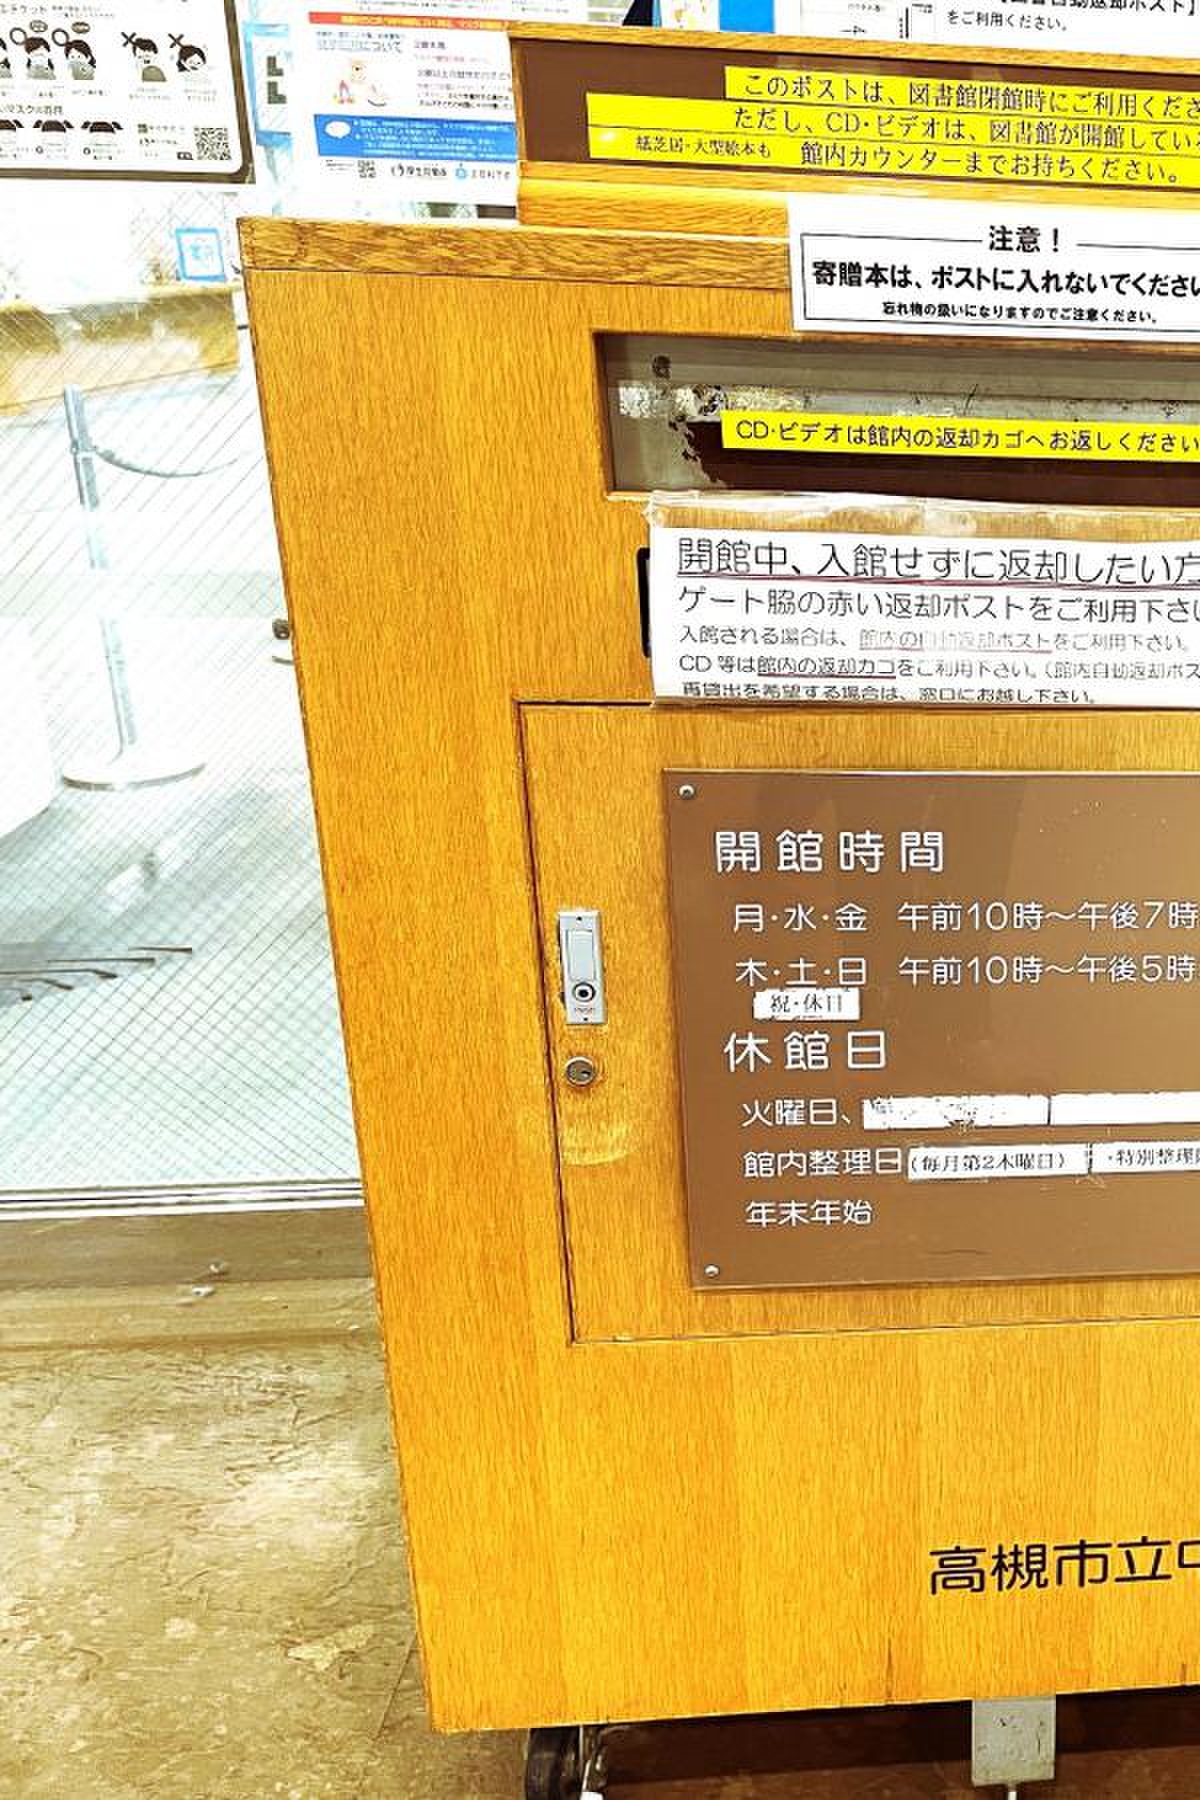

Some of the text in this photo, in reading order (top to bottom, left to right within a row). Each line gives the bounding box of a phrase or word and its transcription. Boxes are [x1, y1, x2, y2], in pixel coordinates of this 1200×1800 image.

[946, 10, 1067, 32] をご利用ください。
[800, 141, 1178, 183] 館内カウンターまでお持ちください。
[988, 225, 1060, 253] 注意！
[882, 301, 1158, 324] 忘れ物の扱いになりますのでご注意ください。
[715, 831, 945, 874] 開館時間
[733, 903, 868, 933] 月・水・金
[735, 958, 867, 987] 木・土・日
[723, 1031, 887, 1072] 休館日
[743, 1148, 901, 1178] 館内整理日
[744, 1200, 873, 1227] 年末年始
